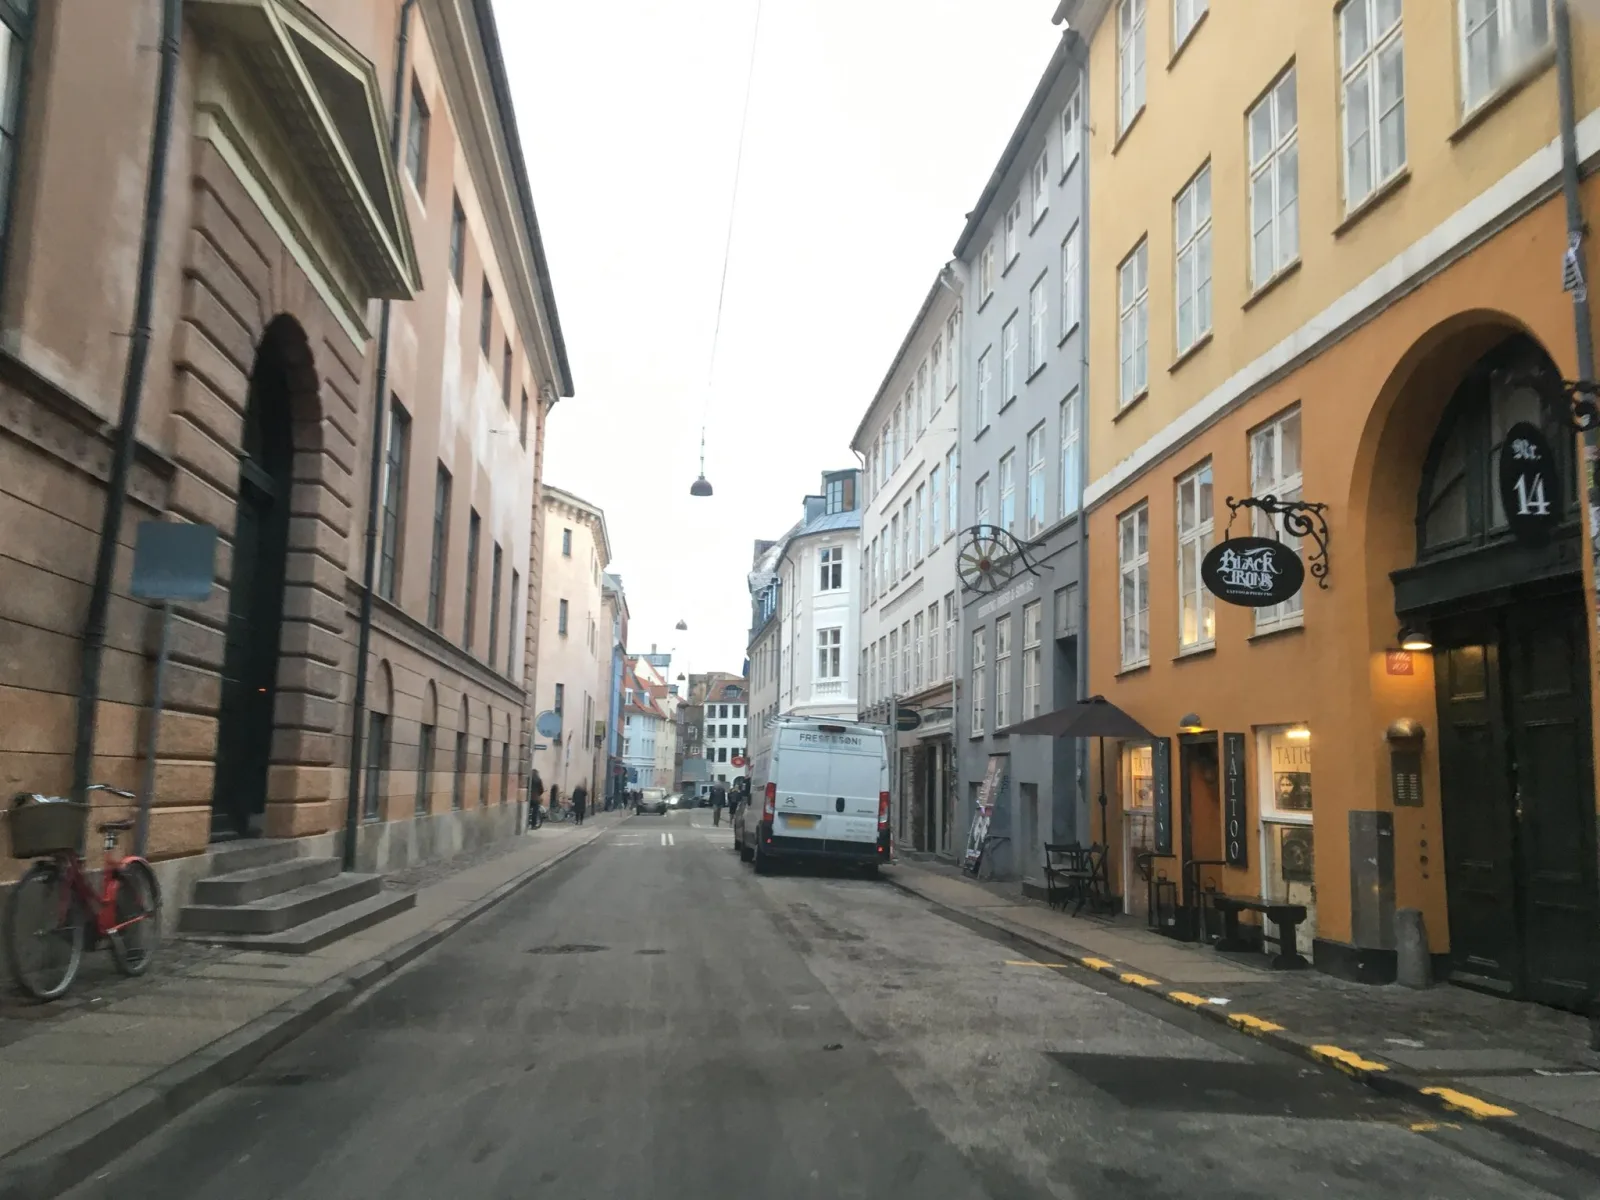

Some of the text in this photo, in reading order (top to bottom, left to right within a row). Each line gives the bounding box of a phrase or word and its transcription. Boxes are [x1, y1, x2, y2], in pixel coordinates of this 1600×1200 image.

[1513, 472, 1551, 515] 14
[1216, 547, 1283, 574] BLACK
[1229, 737, 1239, 859] TATTOO
